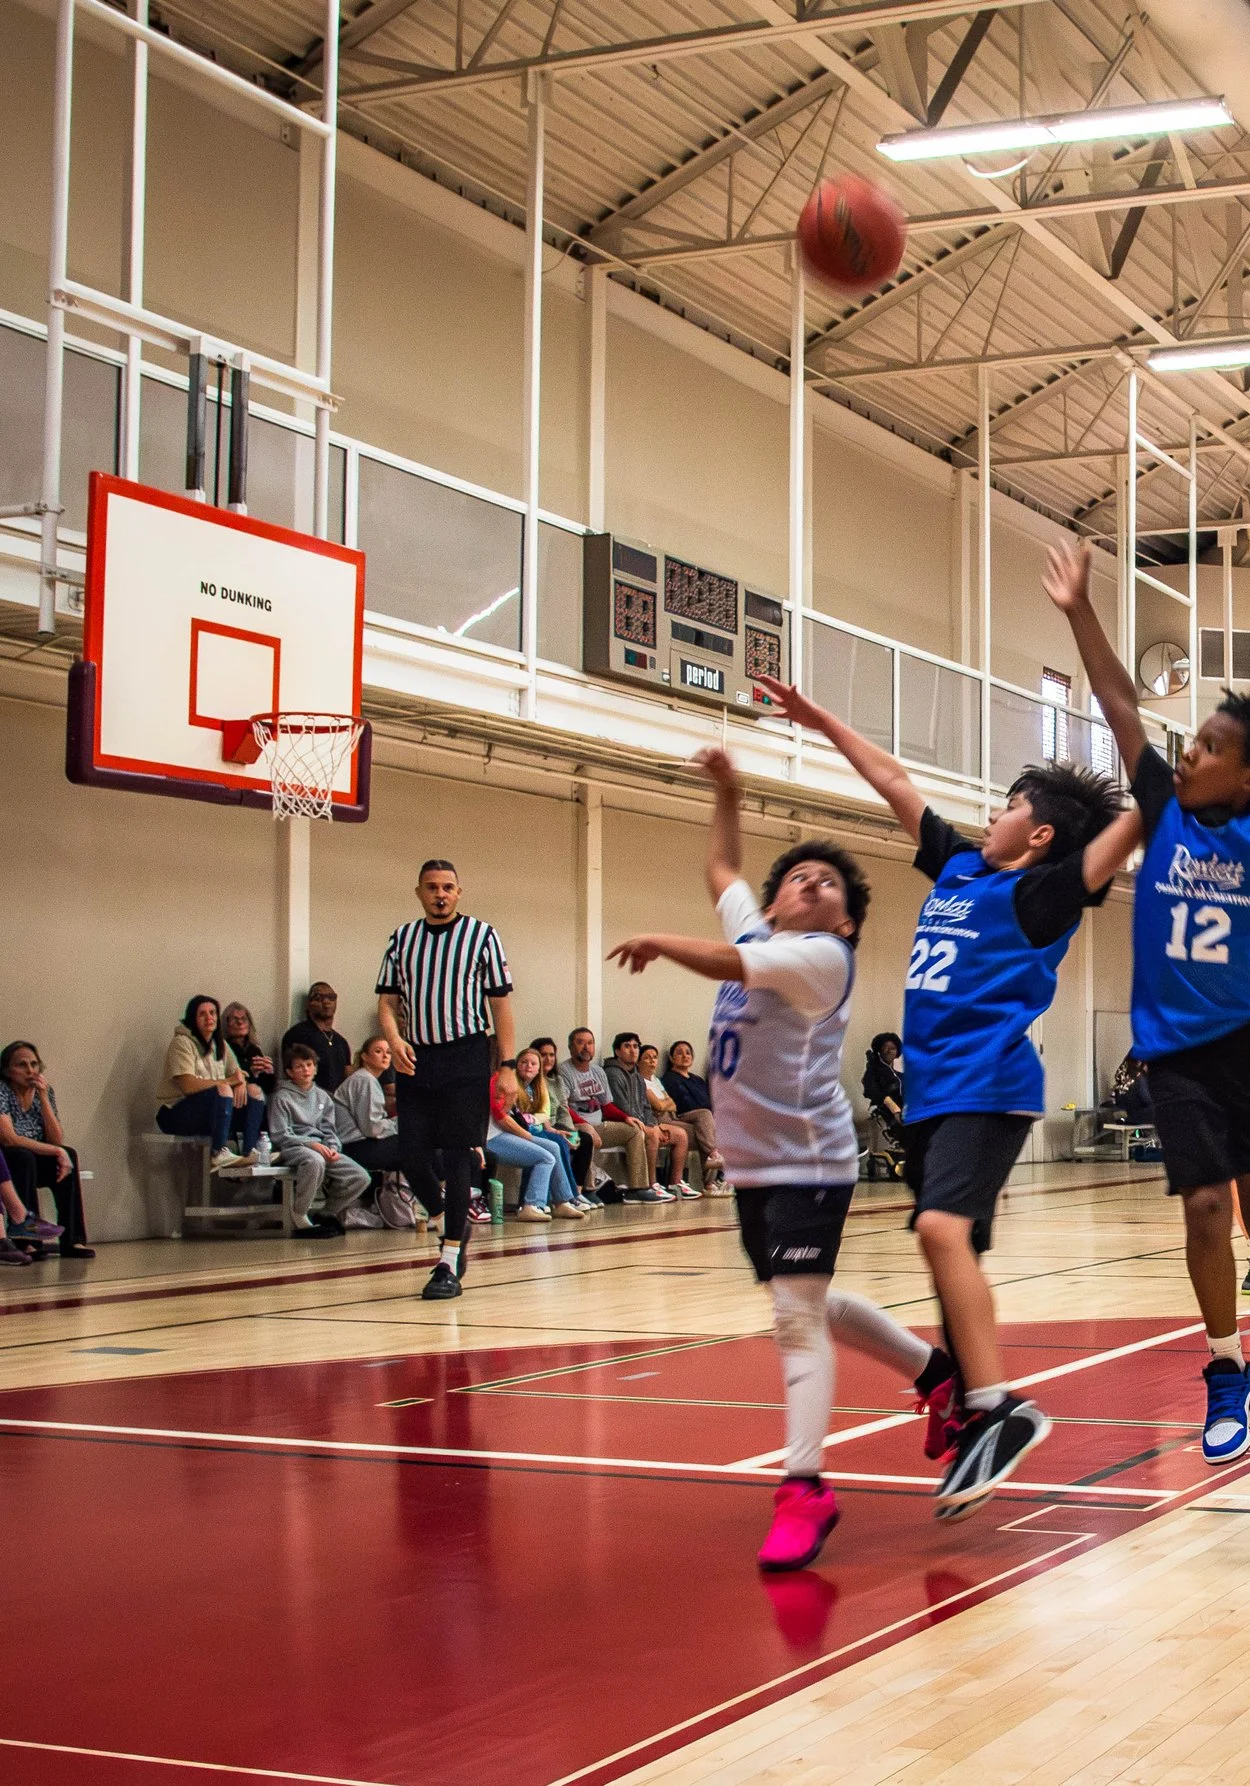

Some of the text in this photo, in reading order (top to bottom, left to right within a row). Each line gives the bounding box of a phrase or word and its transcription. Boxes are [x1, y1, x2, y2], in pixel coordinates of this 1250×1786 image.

[201, 581, 272, 612] NO DUNKING
[686, 664, 719, 691] period
[1165, 901, 1232, 965] 12
[905, 937, 959, 993] 22
